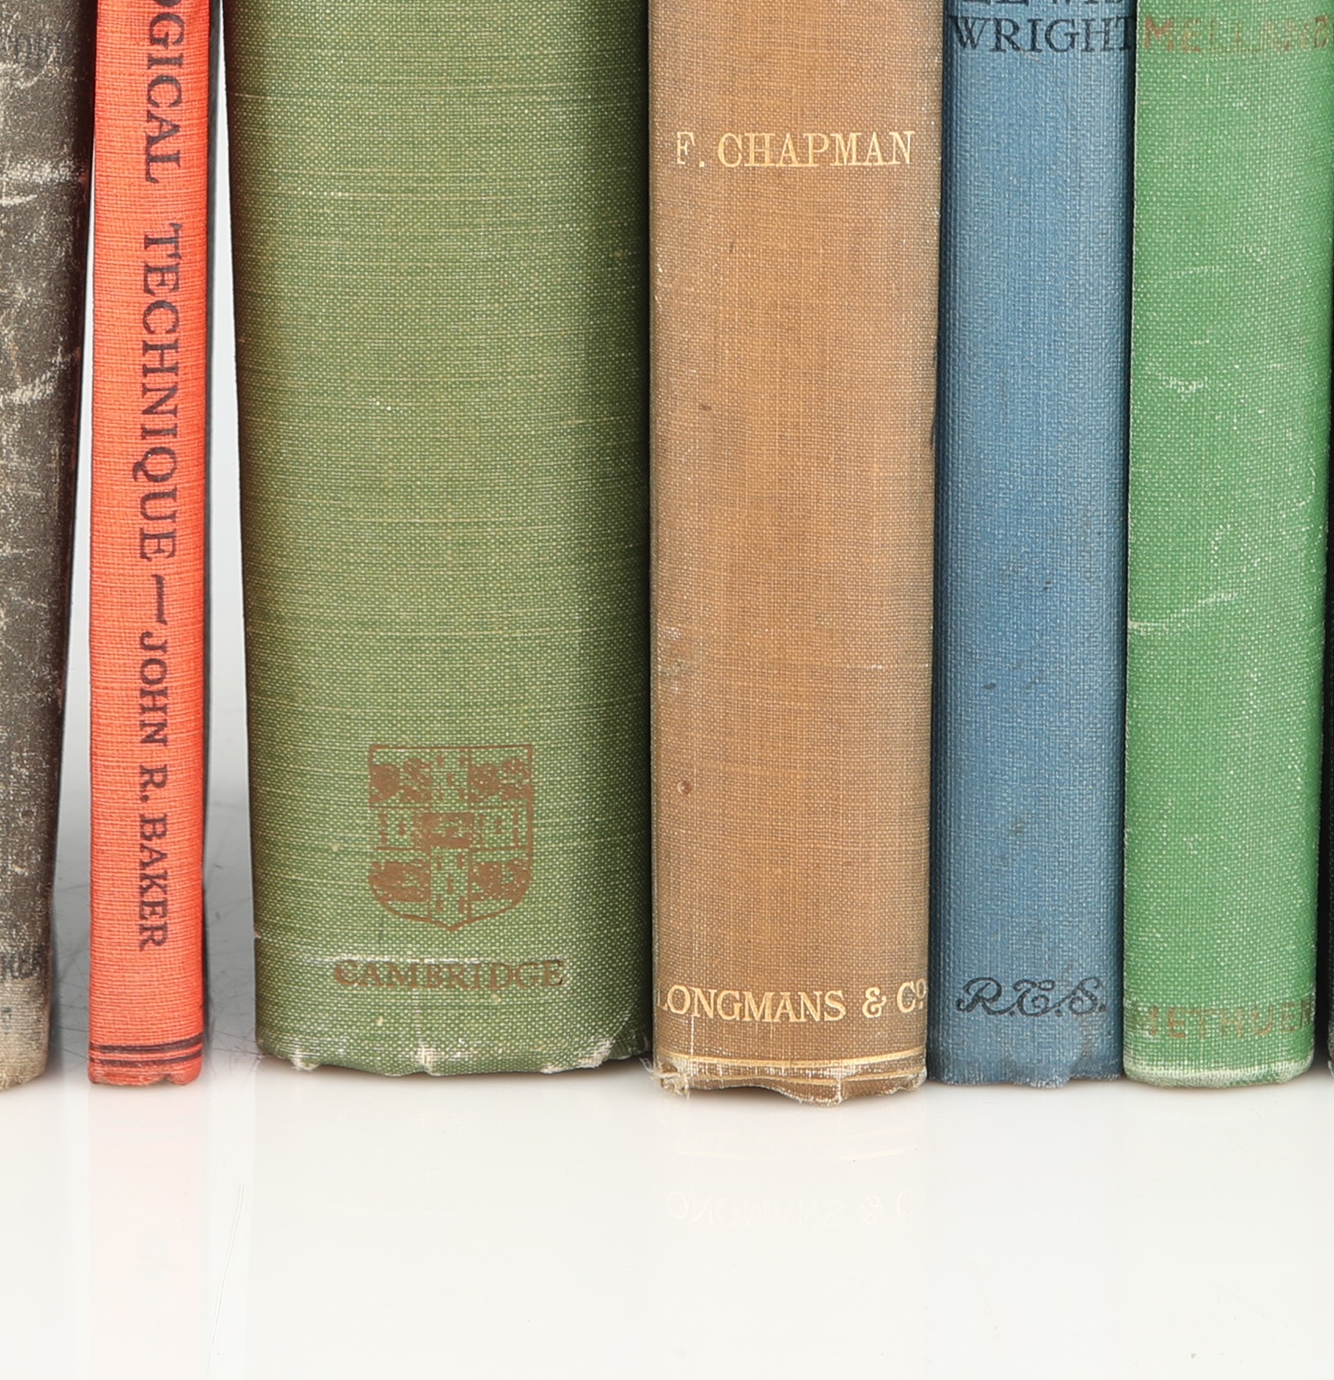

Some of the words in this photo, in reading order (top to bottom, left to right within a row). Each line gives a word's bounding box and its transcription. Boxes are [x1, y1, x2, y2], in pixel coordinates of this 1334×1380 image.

[676, 131, 705, 167] F.
[717, 131, 915, 167] CHAPMAN
[132, 222, 182, 562] TECHNIQUE
[139, 624, 169, 747] JOHN
[139, 766, 169, 804] R.
[137, 812, 168, 952] BAKER
[333, 959, 565, 990] CAMBRIDGE
[862, 987, 886, 1017] &
